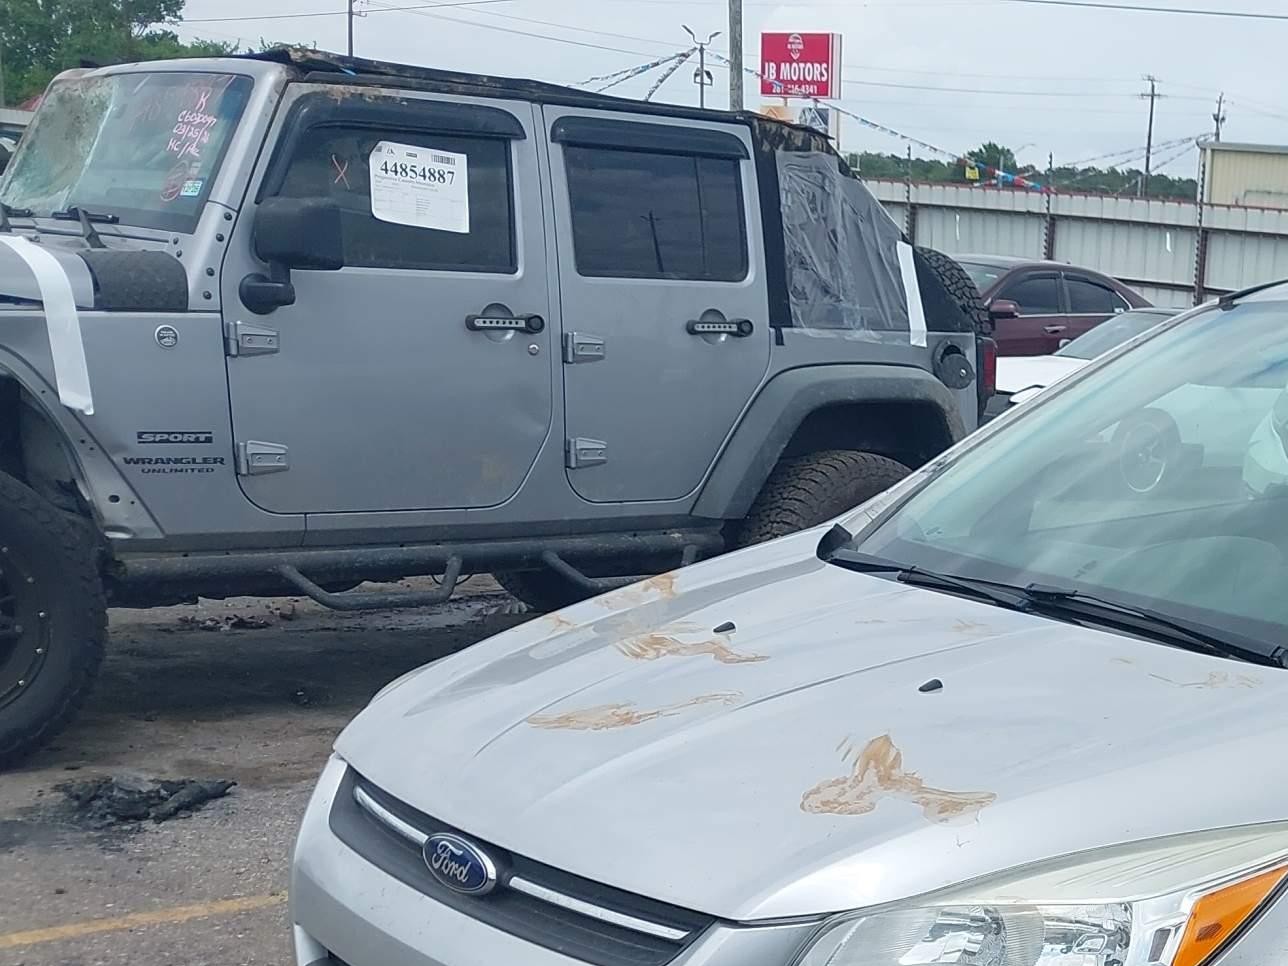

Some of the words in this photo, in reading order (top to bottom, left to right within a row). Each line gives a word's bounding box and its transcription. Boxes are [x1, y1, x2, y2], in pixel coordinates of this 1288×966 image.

[763, 62, 777, 80] JB
[780, 62, 828, 82] MOTORS
[380, 160, 455, 185] 44854887
[138, 433, 212, 442] SPORT
[123, 457, 225, 465] WRANGLER
[431, 840, 473, 883] Ford
